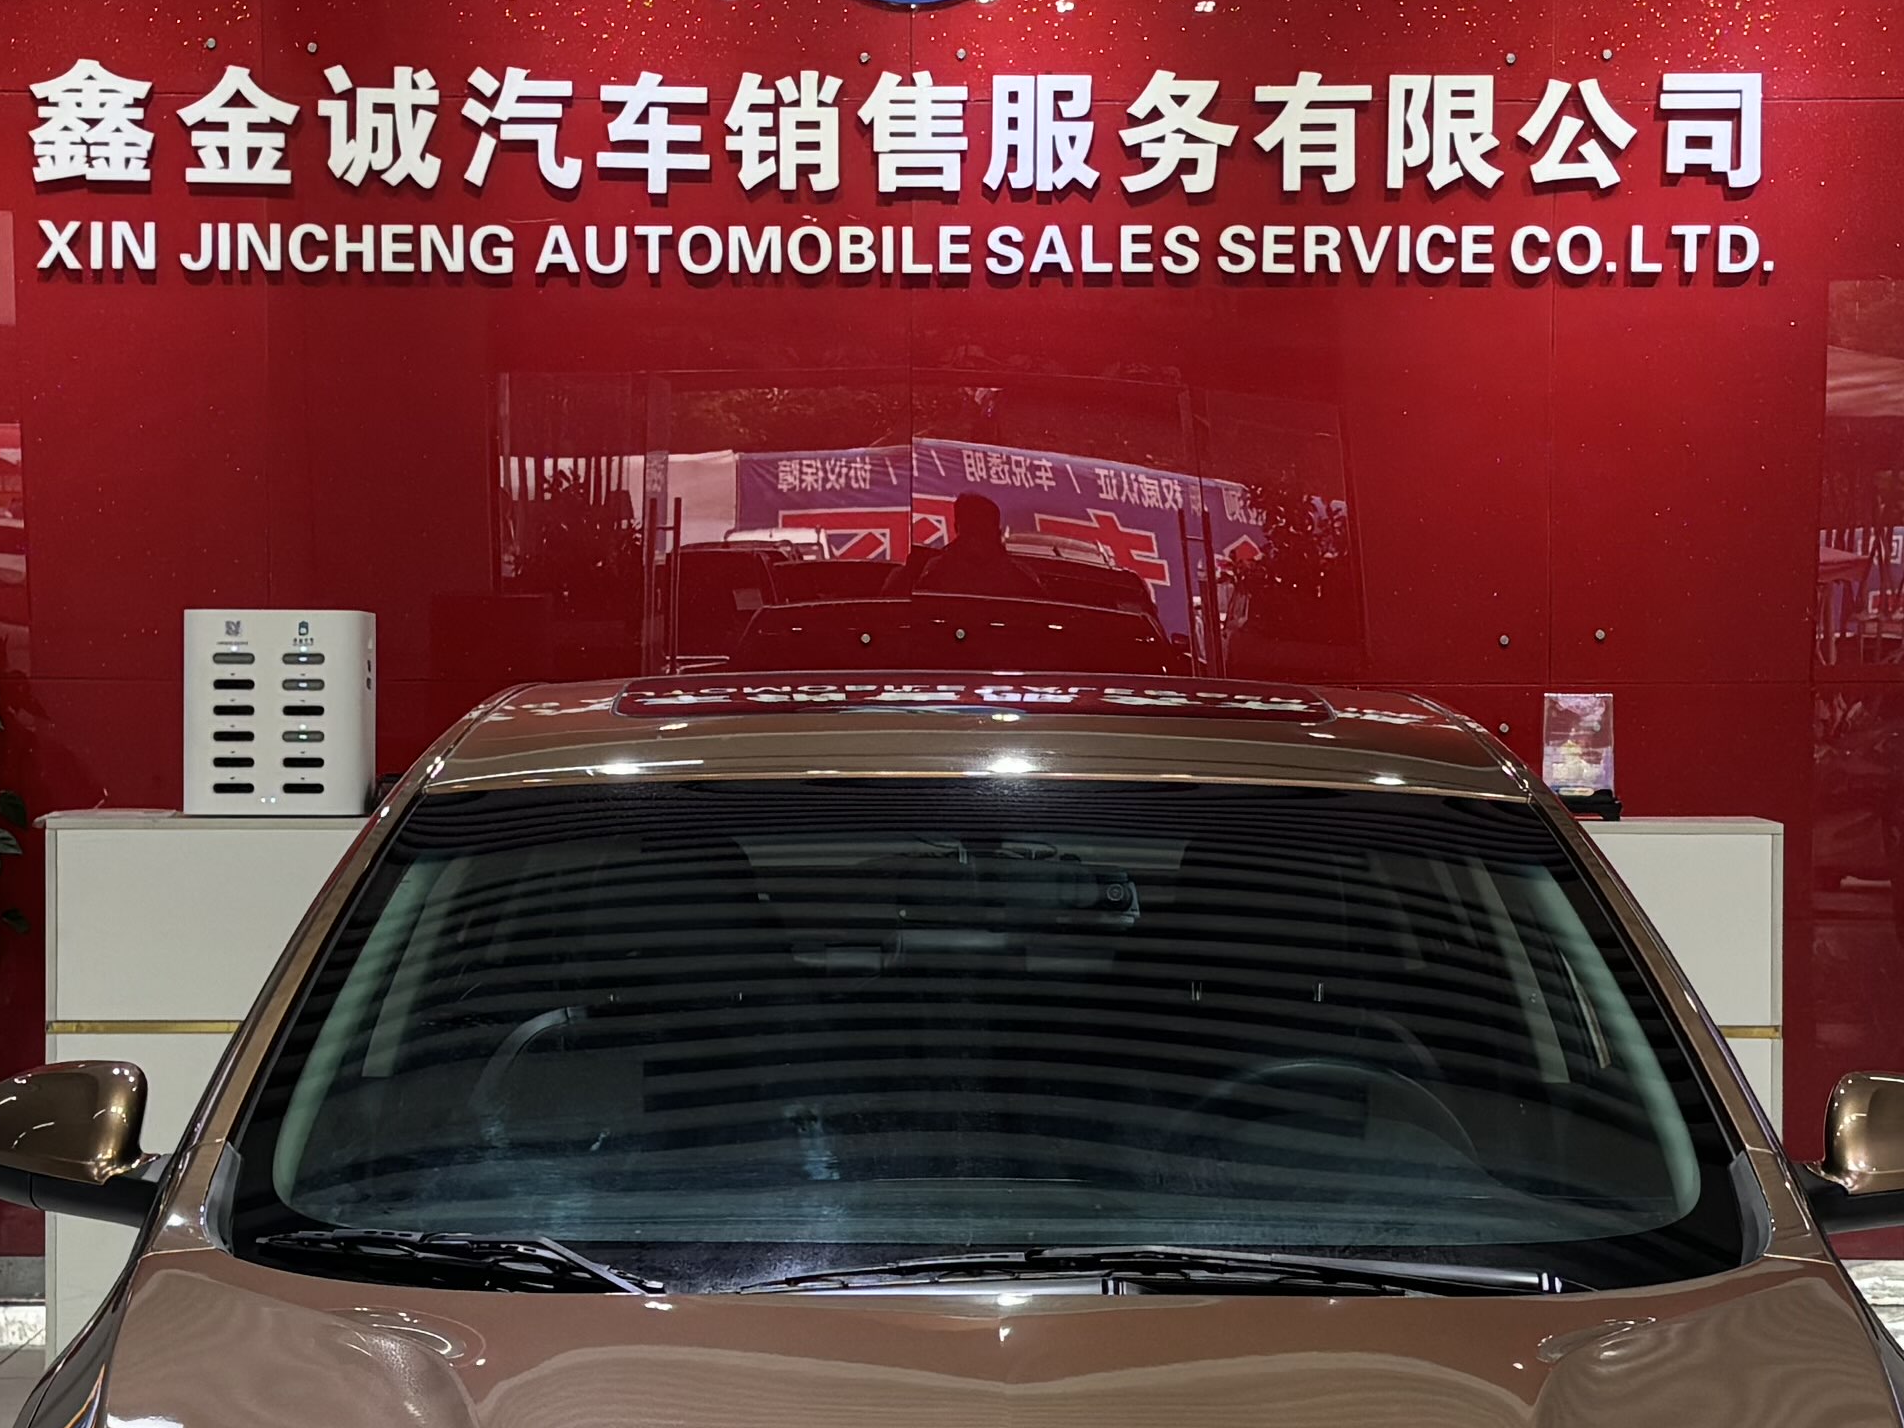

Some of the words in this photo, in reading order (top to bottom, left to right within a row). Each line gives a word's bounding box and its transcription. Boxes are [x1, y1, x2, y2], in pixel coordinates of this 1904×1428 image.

[29, 59, 1764, 194] 鑫金诚汽车销售服务有限公司
[36, 219, 157, 271] XIN
[179, 222, 514, 274] JINCHENG
[534, 224, 972, 275] AUTOMOBILE
[985, 224, 1200, 275] SALES
[1217, 225, 1495, 275] SERVICE
